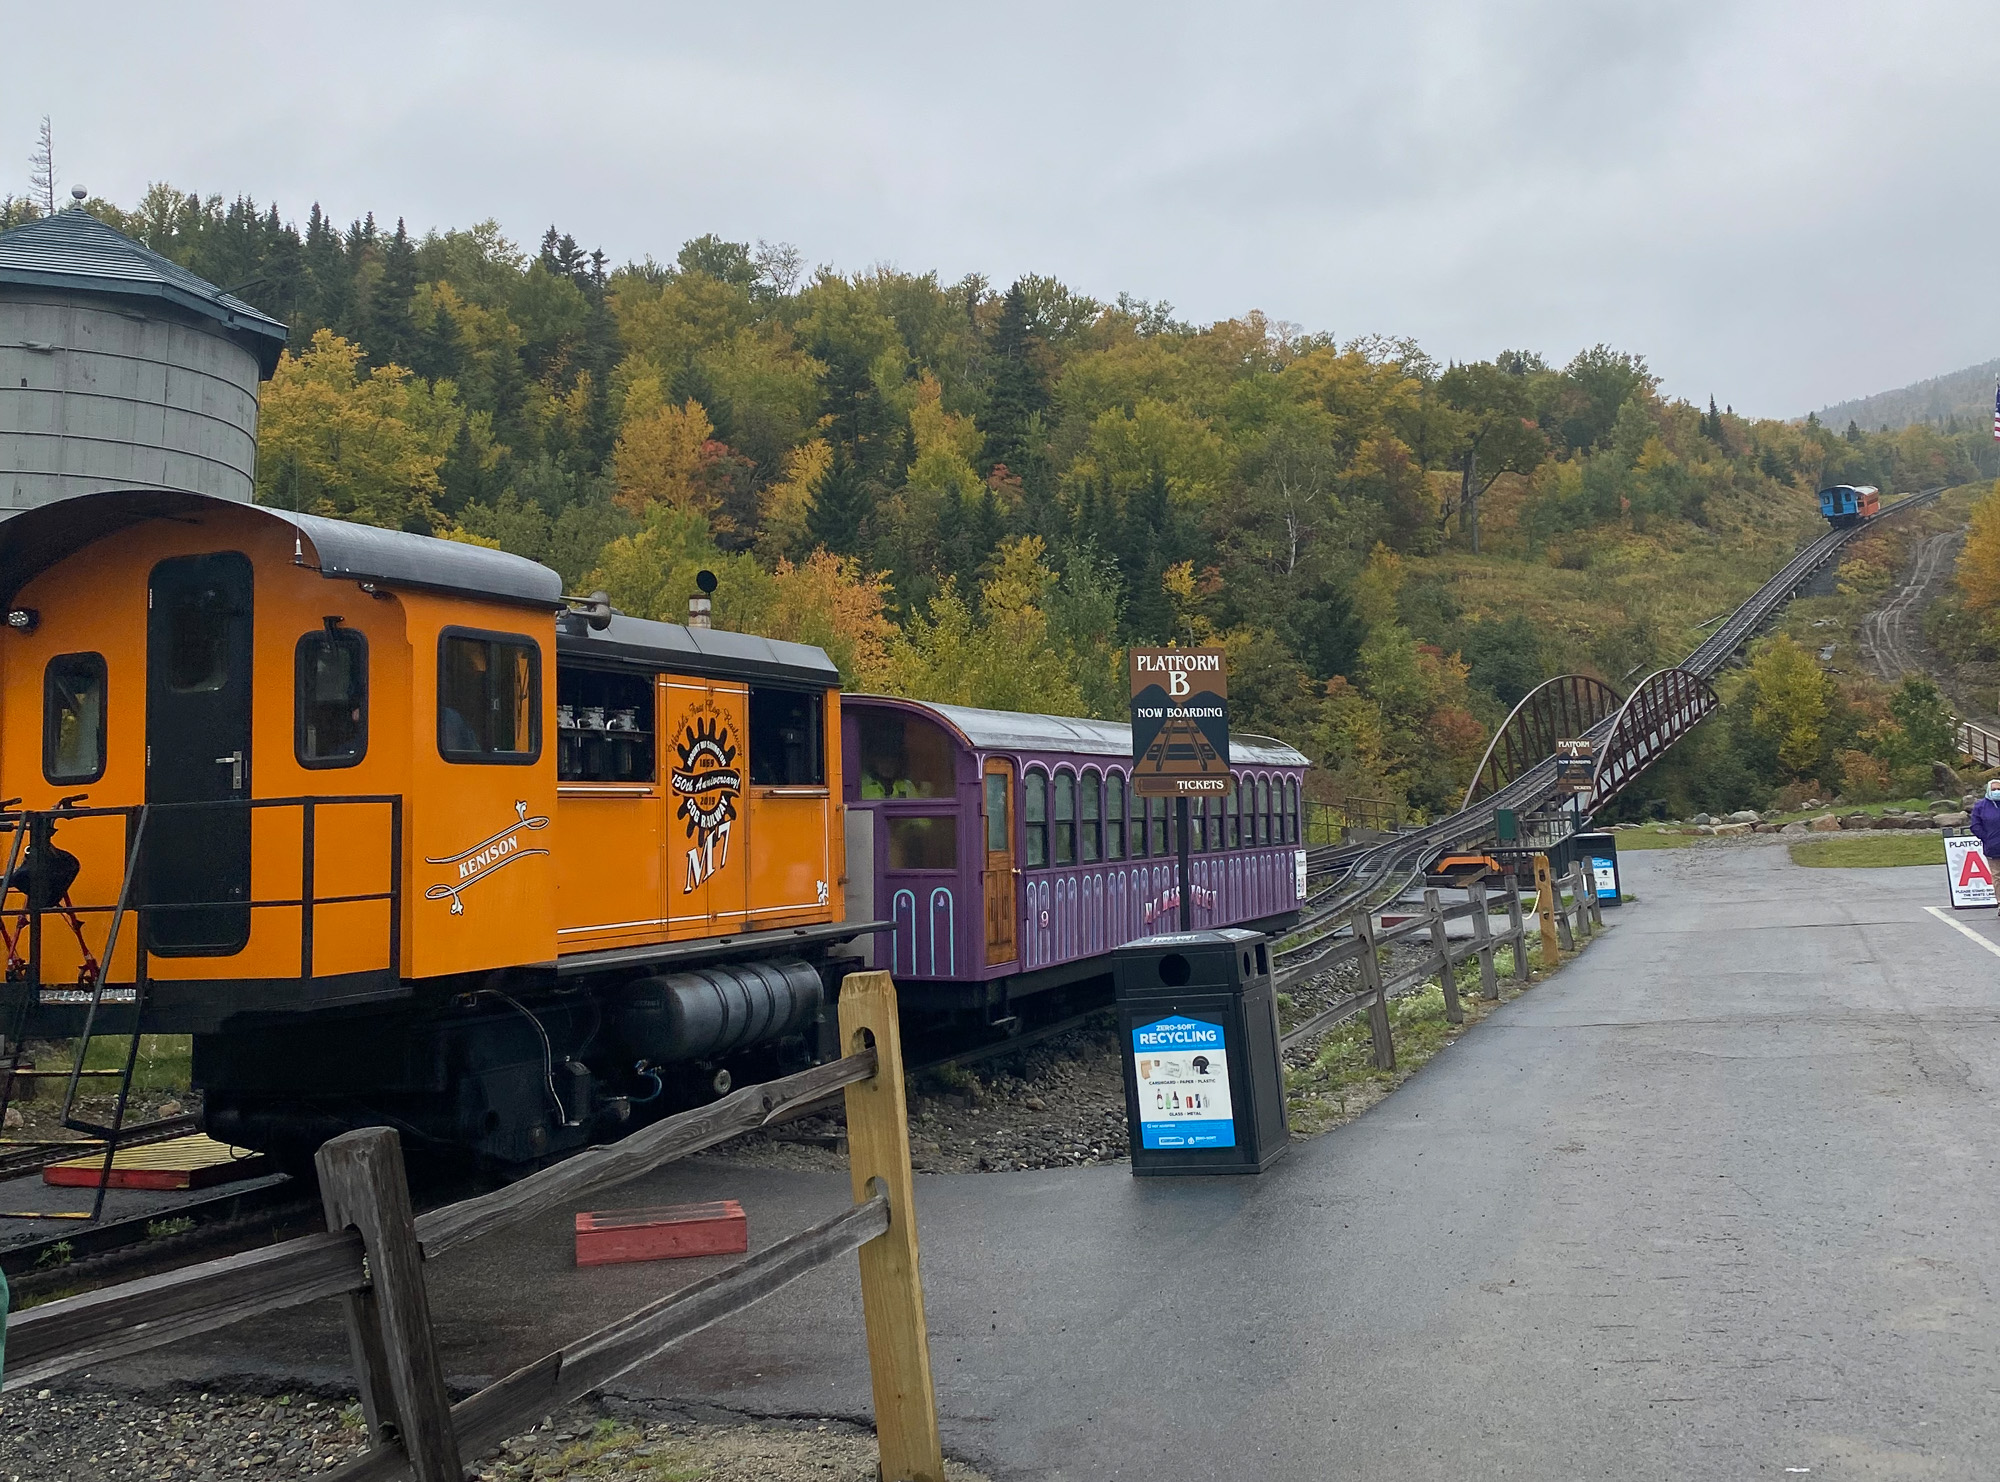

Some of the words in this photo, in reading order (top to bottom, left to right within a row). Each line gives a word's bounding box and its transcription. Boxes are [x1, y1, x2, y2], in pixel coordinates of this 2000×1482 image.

[1136, 655, 1220, 671] PLATFORM
[1168, 670, 1191, 696] B
[1137, 707, 1164, 718] NOW
[1166, 707, 1223, 718] BOARDING
[686, 742, 701, 768] MOUNT
[1570, 747, 1579, 757] A
[699, 758, 715, 768] 1869
[671, 774, 694, 792] 150th
[694, 775, 741, 793] Anniversary!
[1176, 780, 1225, 790] TICKETS
[699, 796, 716, 806] 2019
[686, 798, 701, 823] COG
[700, 795, 728, 828] RAILWAY
[458, 835, 518, 879] KENISON
[683, 820, 731, 894] M7
[1958, 850, 1993, 887] A
[1041, 910, 1049, 929] 9
[1155, 1023, 1197, 1032] ZERO-SORT
[1140, 1030, 1217, 1045] RECYCLING
